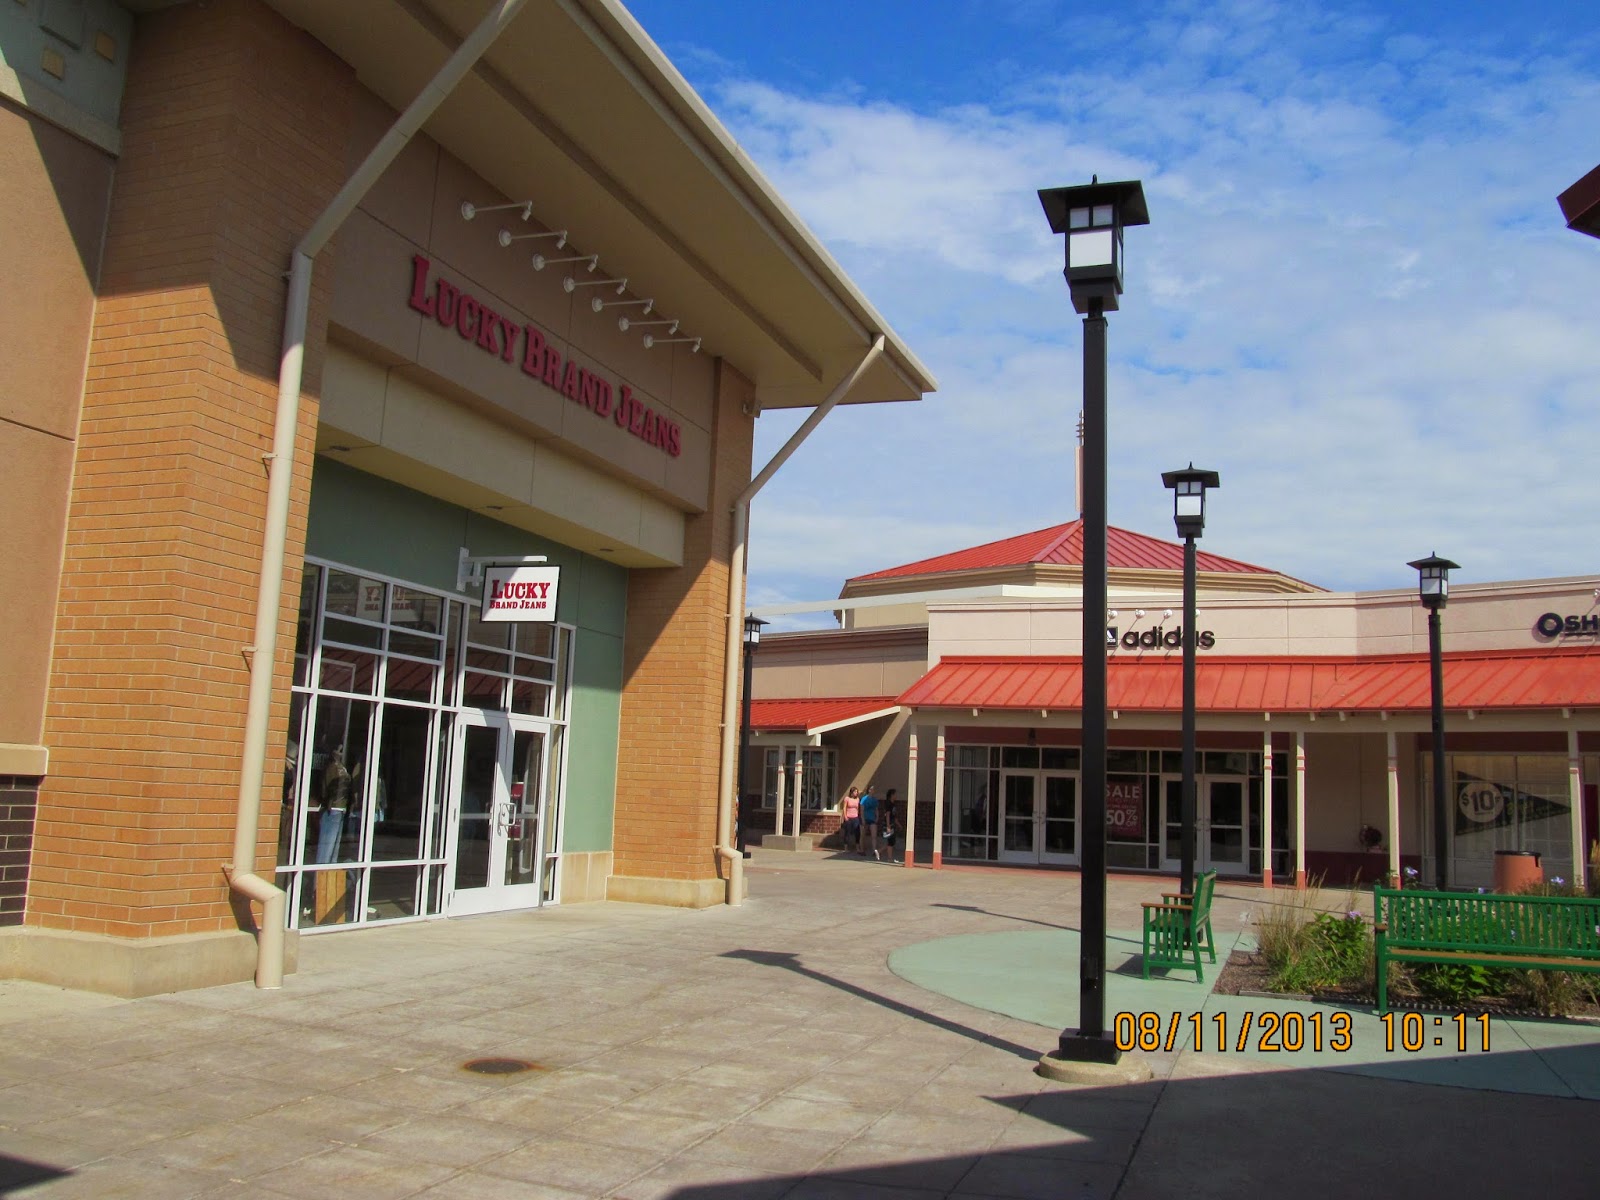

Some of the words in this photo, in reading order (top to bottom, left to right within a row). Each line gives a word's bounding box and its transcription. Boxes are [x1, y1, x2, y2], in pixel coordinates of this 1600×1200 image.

[409, 254, 521, 363] LUCKY
[521, 324, 613, 418] BRAND
[616, 384, 681, 457] JEANS
[490, 579, 551, 599] LUCKY
[489, 599, 518, 609] BRAND
[520, 599, 547, 609] JEANS
